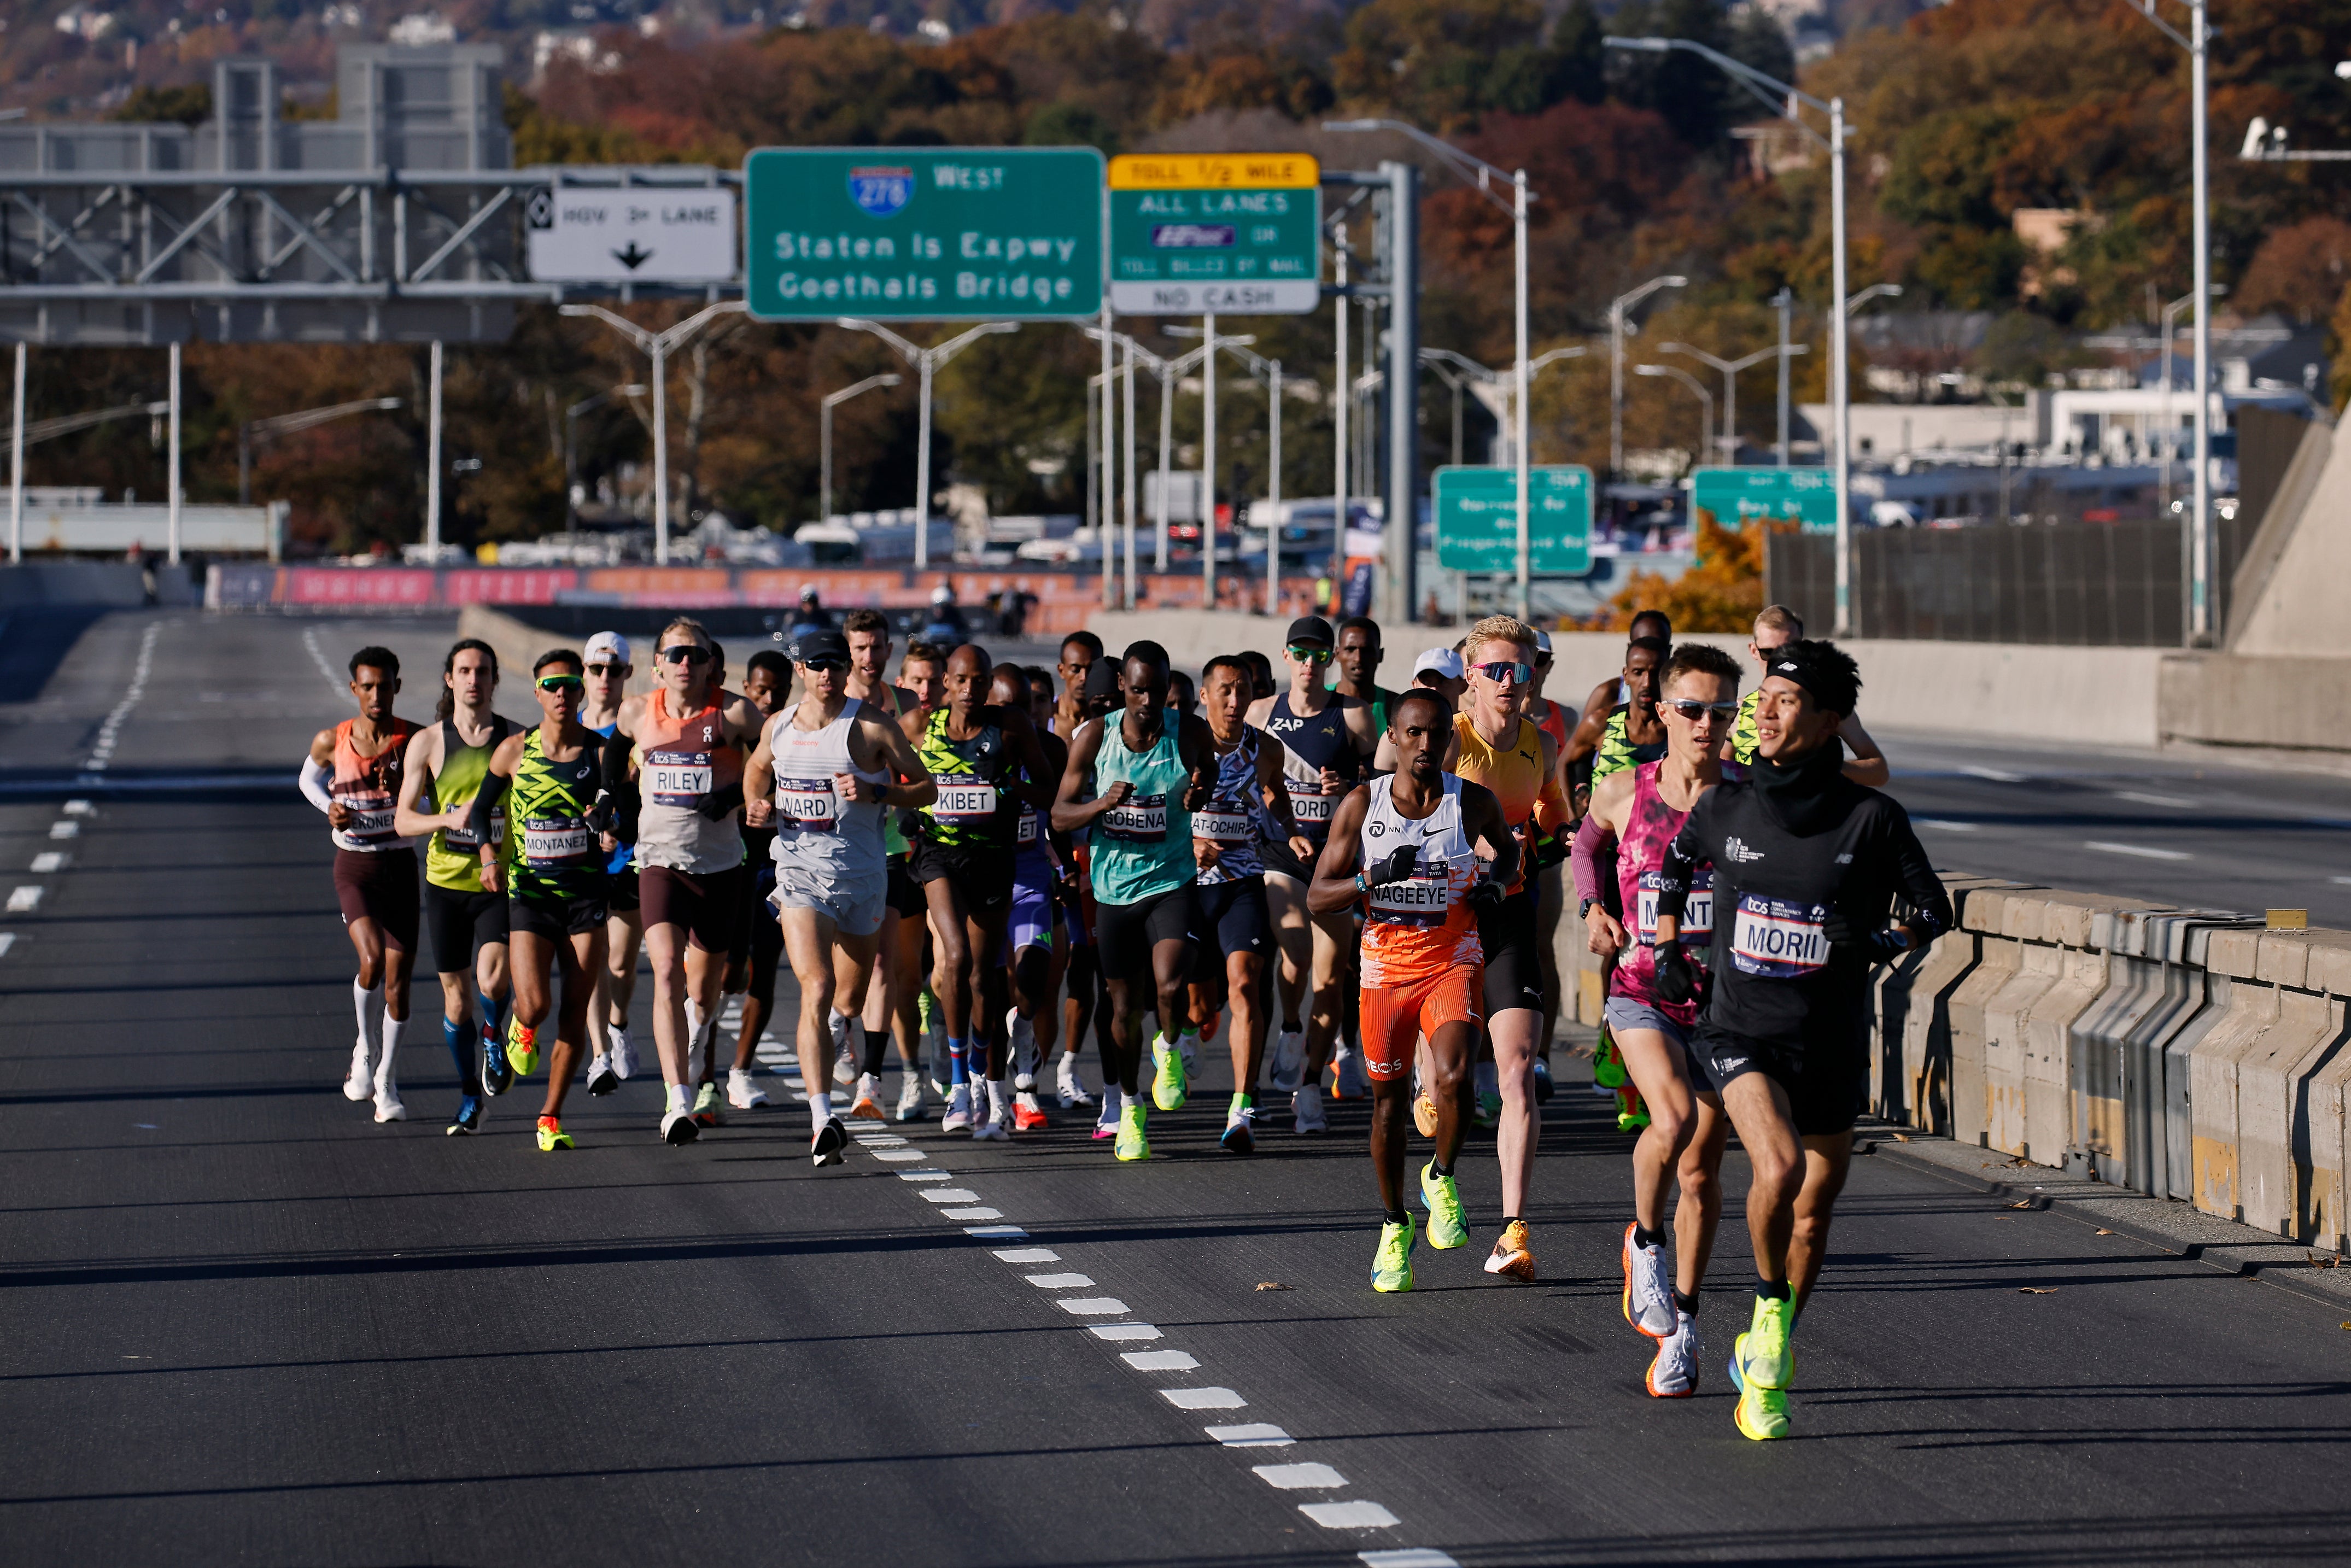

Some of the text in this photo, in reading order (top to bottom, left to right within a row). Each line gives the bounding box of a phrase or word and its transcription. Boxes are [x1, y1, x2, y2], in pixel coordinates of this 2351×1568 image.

[1131, 162, 1182, 181] TOLL
[1245, 162, 1294, 179] MILE
[858, 179, 907, 207] 278
[933, 165, 1004, 189] WEST
[1139, 192, 1289, 214] ALL LANES
[563, 206, 606, 225] HOV
[660, 206, 720, 225] LANE
[775, 231, 1076, 262] Staten Is Expwy
[777, 271, 1073, 304] Goethals Bridge
[1154, 287, 1275, 306] NO CASH
[1271, 717, 1304, 732] ZAP
[657, 772, 703, 790] RILEY
[780, 778, 791, 789] tcs
[937, 774, 952, 785] tcs
[781, 796, 826, 817] WARD
[939, 792, 987, 810] KIBET
[530, 819, 544, 830] tcs
[1104, 811, 1166, 829] GOBENA
[1020, 821, 1036, 839] ET
[526, 835, 587, 851] MONTANEZ
[1647, 873, 1661, 888] tc
[1371, 885, 1447, 905] NAGEEYE
[1645, 900, 1711, 926] MNT
[1747, 896, 1769, 915] tcs
[1770, 906, 1803, 916] CONSULTANCY
[1747, 923, 1818, 959] MORII
